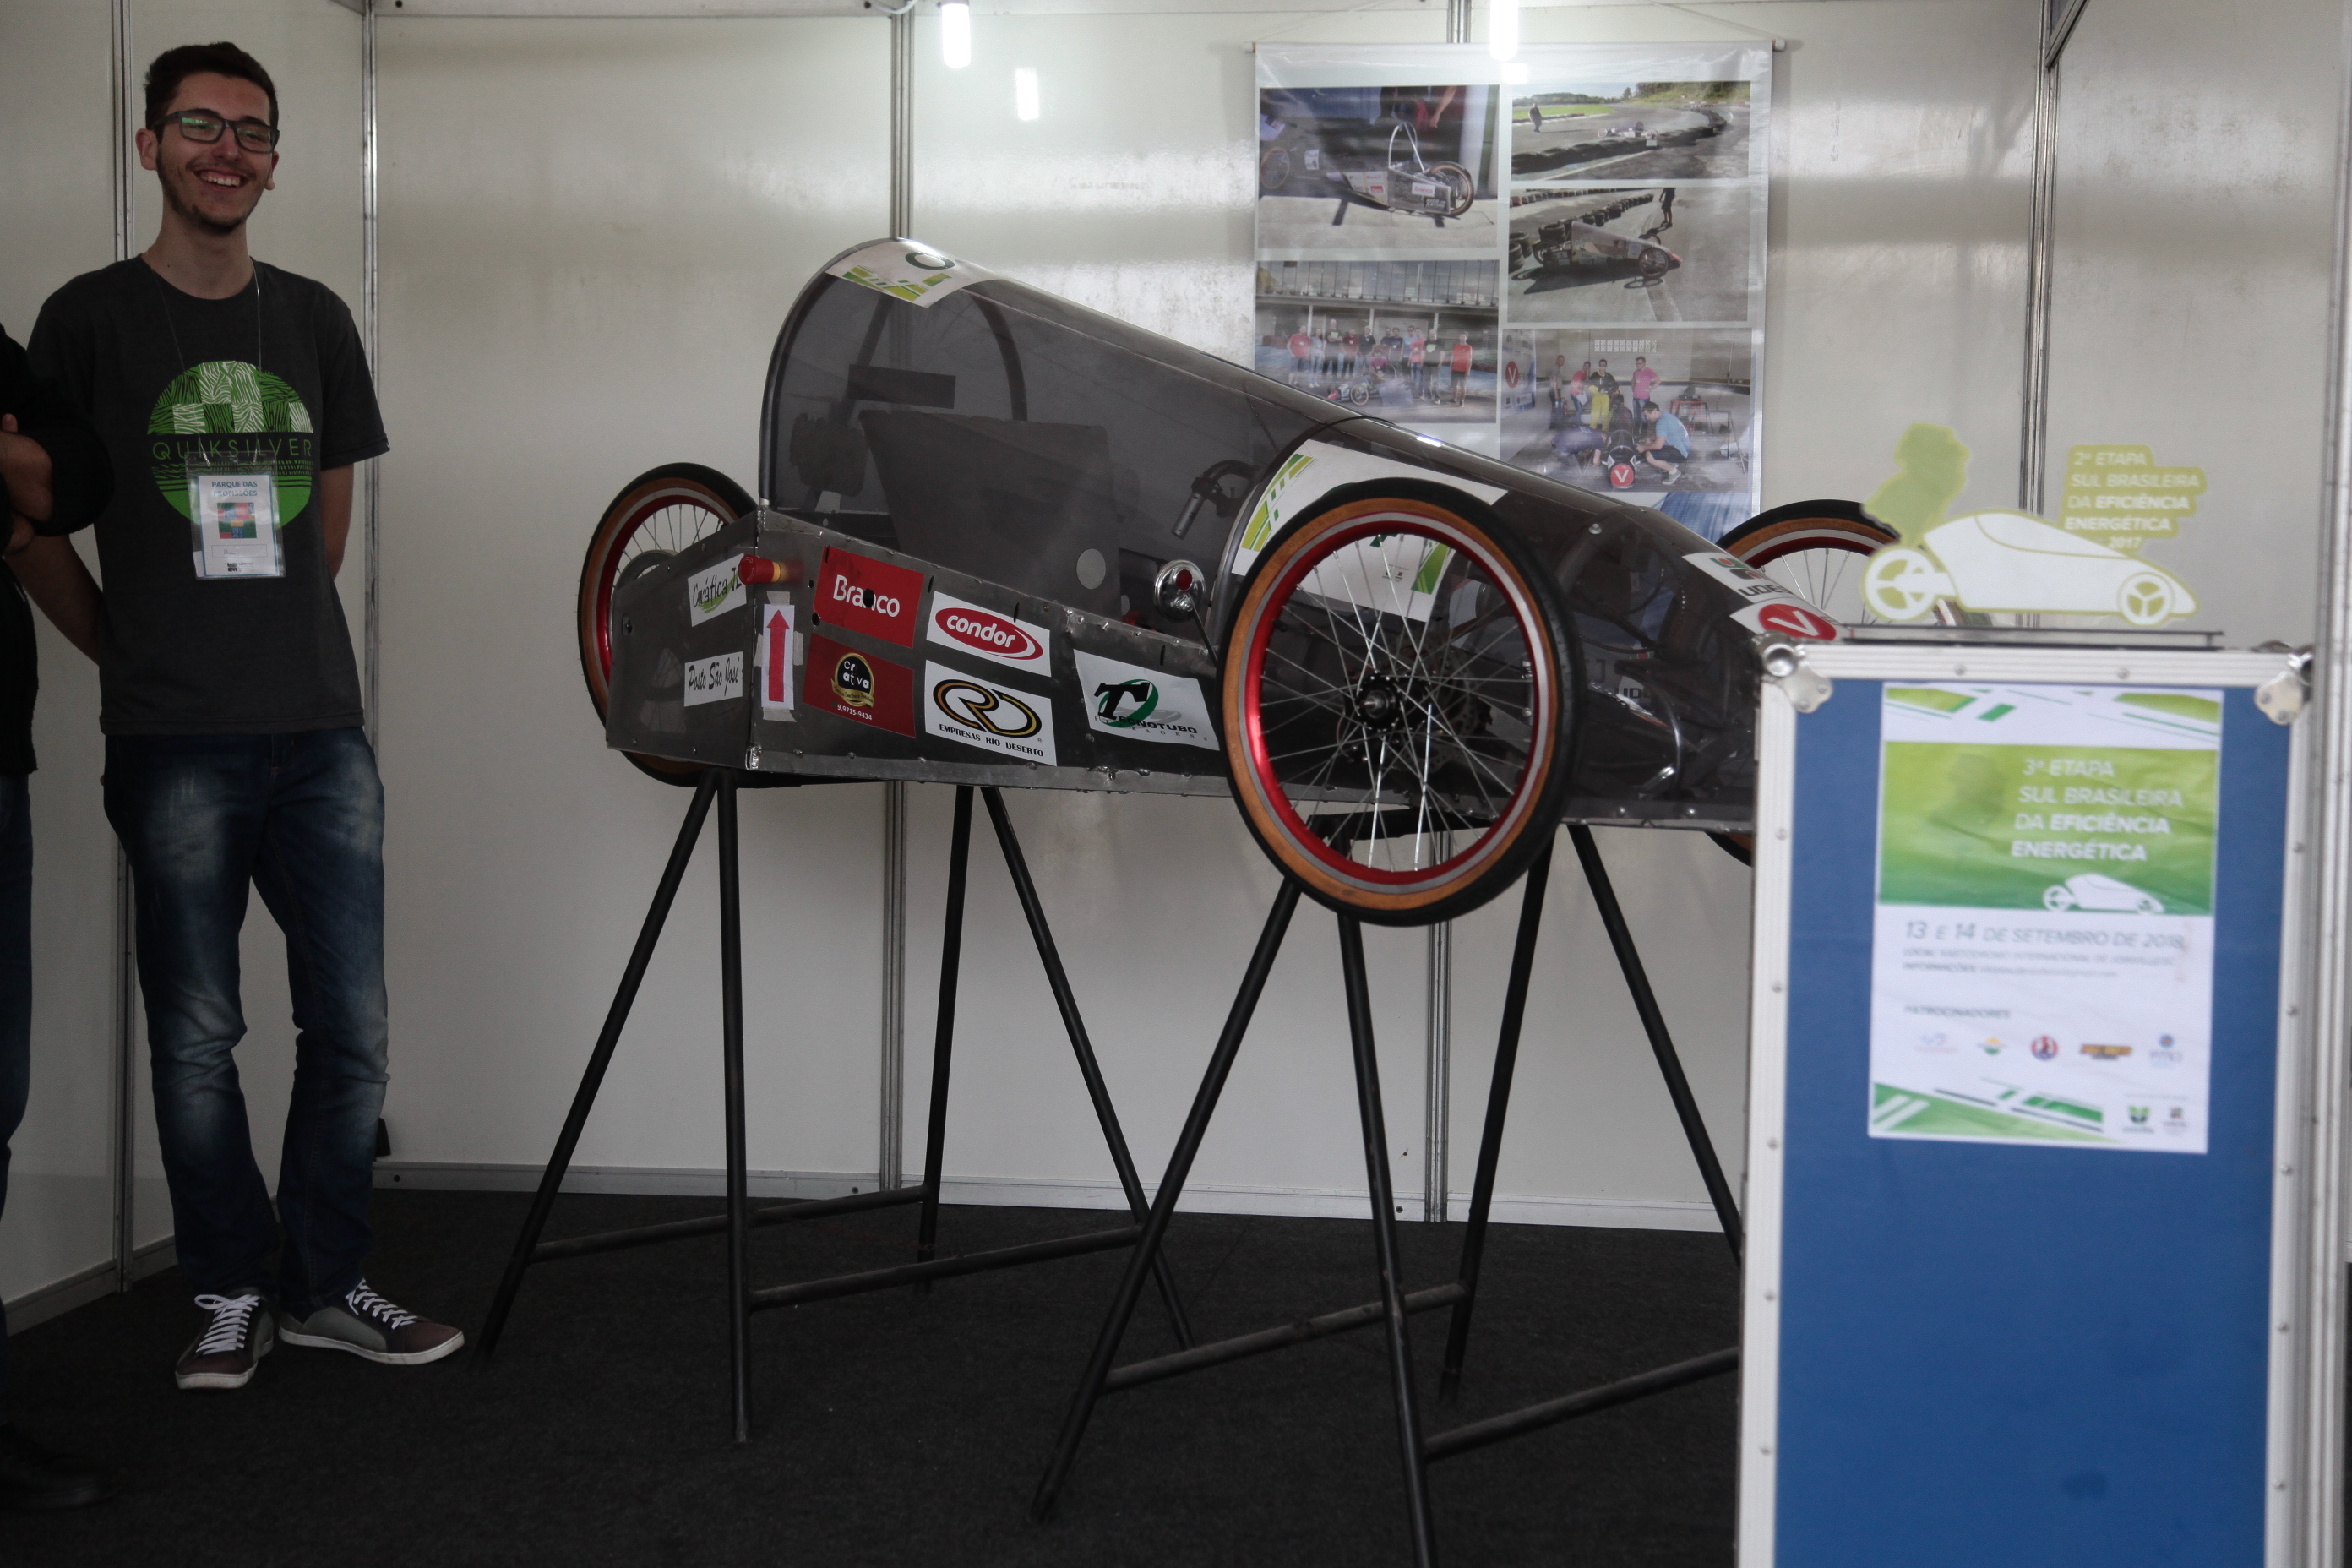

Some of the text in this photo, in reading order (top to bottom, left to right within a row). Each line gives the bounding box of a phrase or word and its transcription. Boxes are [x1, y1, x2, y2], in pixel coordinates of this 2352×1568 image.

[152, 438, 313, 460] QUIKSILVER
[2094, 452, 2148, 466] ETAPA
[2071, 473, 2200, 487] SUL BRASILEIRA
[213, 488, 258, 497] PROFISSÕES
[2066, 492, 2191, 509] DA EFICIÊNCIA
[2064, 514, 2172, 531] ENERGÉTICA
[946, 615, 1016, 648] condor
[689, 664, 706, 695] Posto
[708, 662, 723, 690] São
[939, 723, 1044, 757] EMPRESAS RIO DESERTO
[2049, 759, 2115, 777] ETAPA
[2018, 786, 2184, 808] SUL BRASILEIRA
[2014, 811, 2171, 834] DA EFICIÊNCIA
[2011, 837, 2148, 861] ENERGÉTICA
[1906, 920, 1928, 939] 13
[1935, 925, 1946, 940] E
[1955, 922, 1976, 940] 14
[1983, 927, 2008, 942] DE
[2012, 928, 2110, 945] SETEMBRO
[2113, 930, 2139, 947] DE
